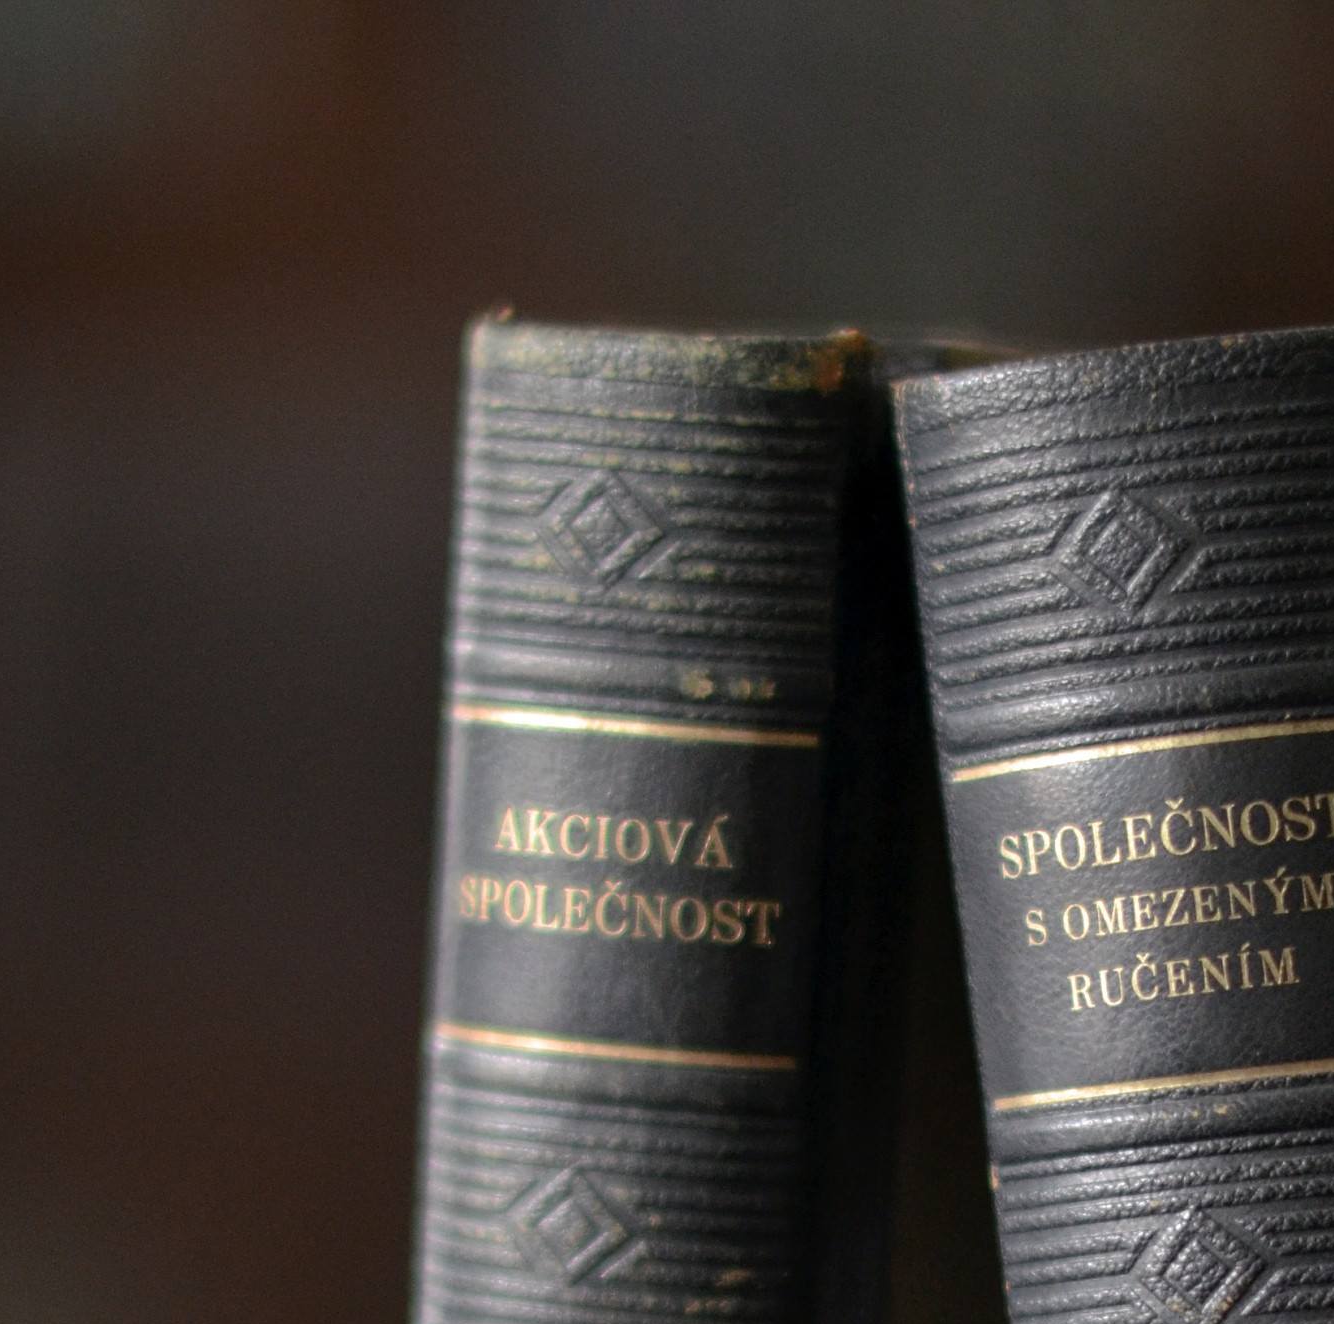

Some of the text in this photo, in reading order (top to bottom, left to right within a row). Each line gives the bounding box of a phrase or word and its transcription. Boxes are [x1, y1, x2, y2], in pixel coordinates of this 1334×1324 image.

[495, 807, 733, 869] AKCIOVÁ
[460, 874, 781, 946] SPOLEČNOST
[1025, 908, 1048, 946] S
[1067, 943, 1301, 1012] RUČENÍM
